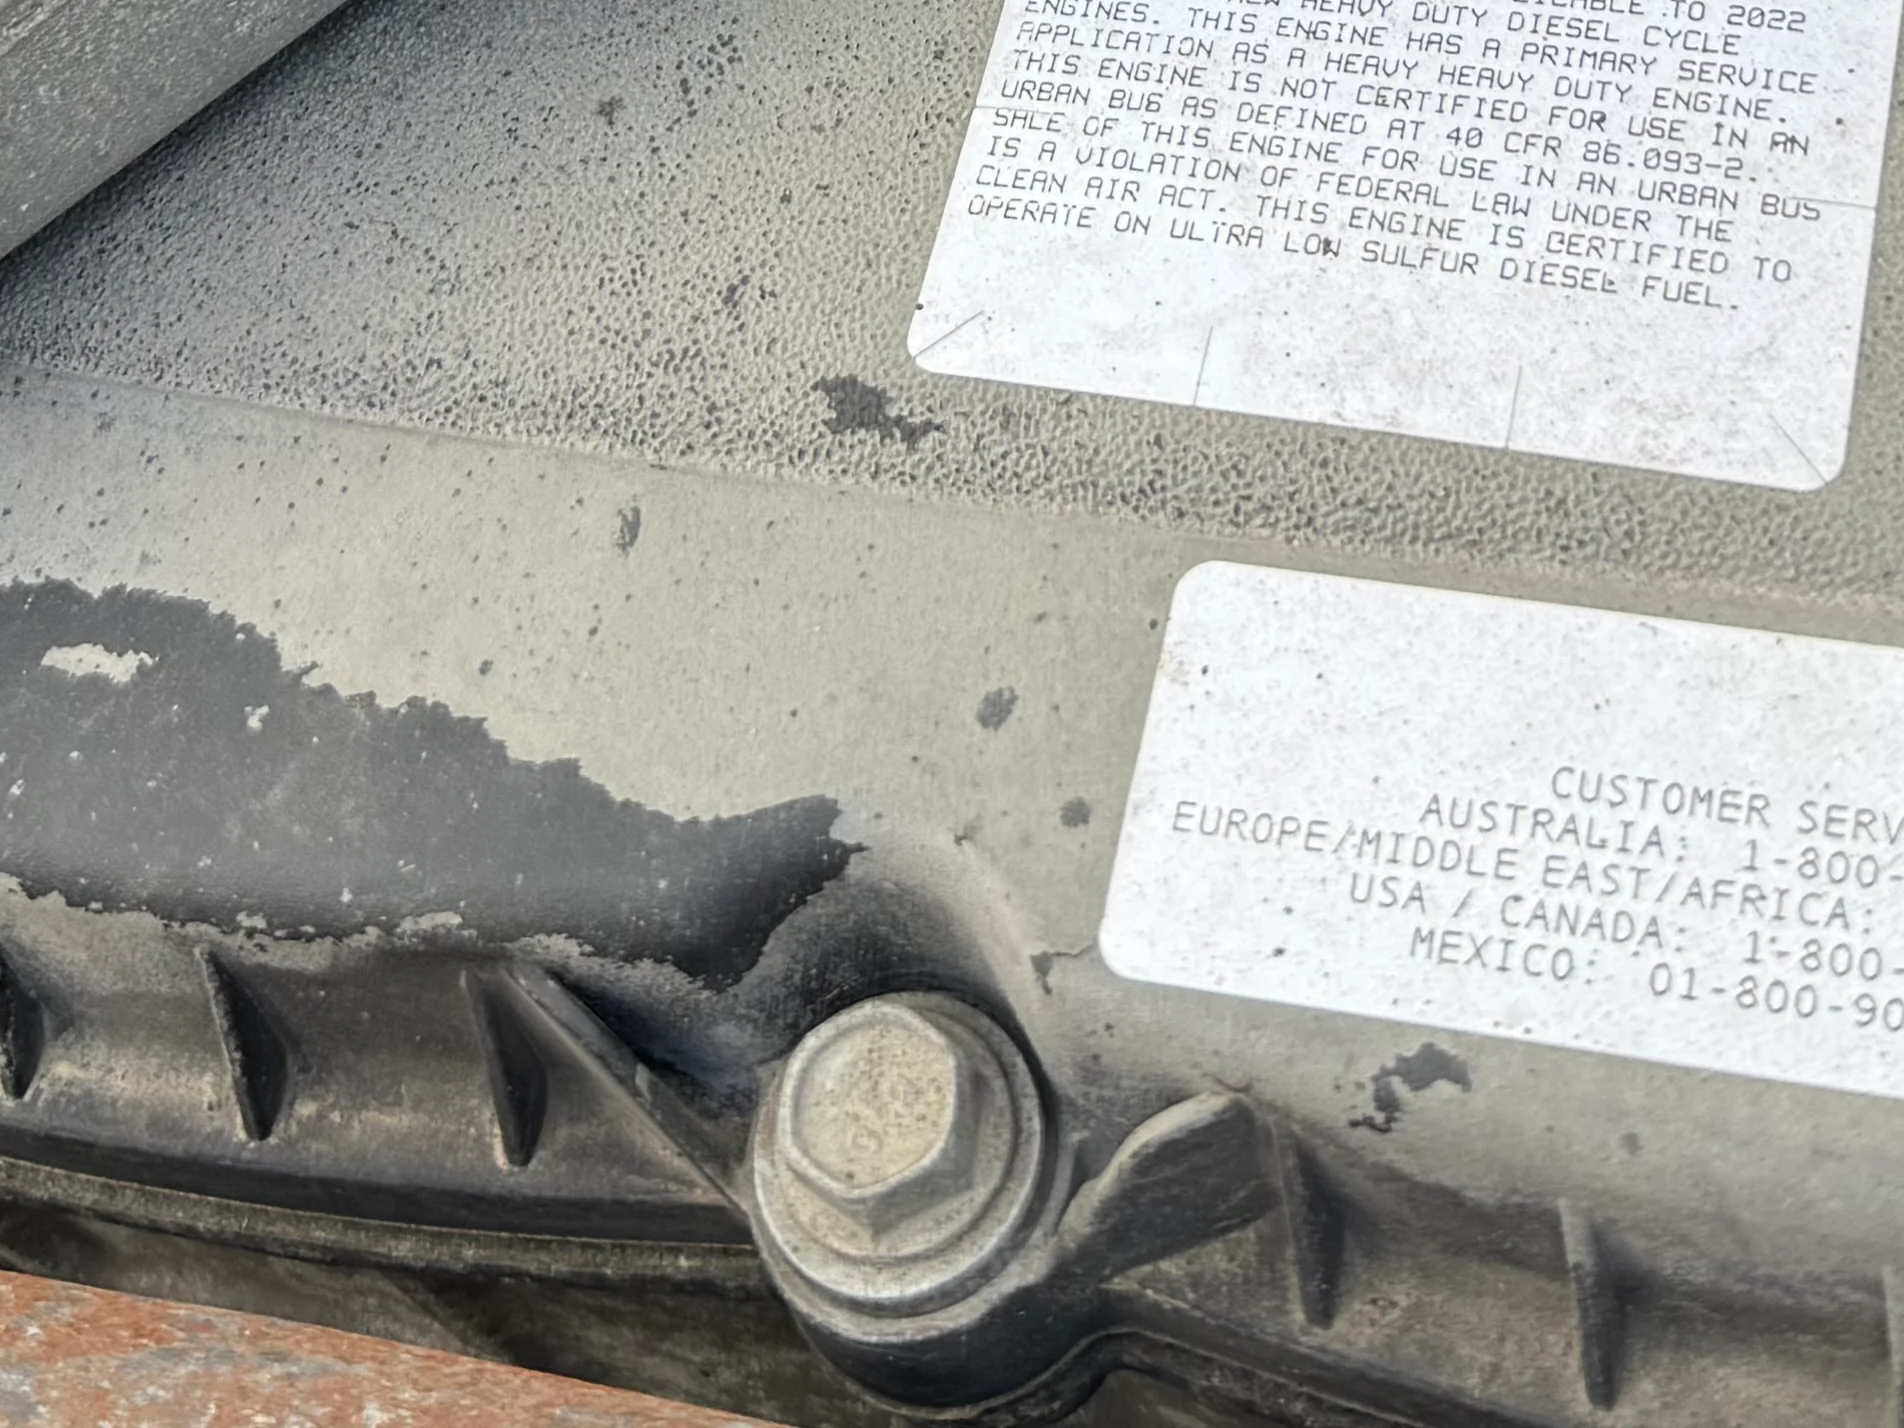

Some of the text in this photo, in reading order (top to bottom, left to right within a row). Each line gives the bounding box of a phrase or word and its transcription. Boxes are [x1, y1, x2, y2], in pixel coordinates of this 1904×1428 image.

[1187, 6, 1258, 34] THIS
[1275, 16, 1389, 47] ENGINE
[1405, 30, 1463, 55] HAS
[1481, 37, 1501, 59] A
[1520, 41, 1656, 76] PRIMARY
[1677, 59, 1817, 95] SERVICE
[1411, 0, 1488, 28] DUTY
[1506, 10, 1620, 43] DIESEL
[1642, 25, 1741, 56] CYCLE
[1726, 4, 1805, 33] 2022
[1015, 20, 1786, 123] APPLICATION AS A HEAVY HEAVY DUTY ENGINE.
[1000, 79, 1757, 182] URBAN BUS AS DEFINED AT 40 CFR 86.093-2.
[986, 135, 1731, 243] IS A VIOLATION OF FEDERAL LAW UNDER THE
[967, 194, 1738, 310] OPERATE ON ULTRA LOW SULFUR DIESEL FUEL.
[1418, 793, 1688, 862] AUSTRALIA:
[1551, 766, 1771, 829] CUSTOMER
[1171, 800, 1520, 882] EUROPE/MIDDLE
[1541, 854, 1873, 935] EAST/AFRICA:
[1349, 871, 1426, 915] USA
[1499, 894, 1687, 953] CANADA:
[1408, 926, 1598, 986] MEXICO:
